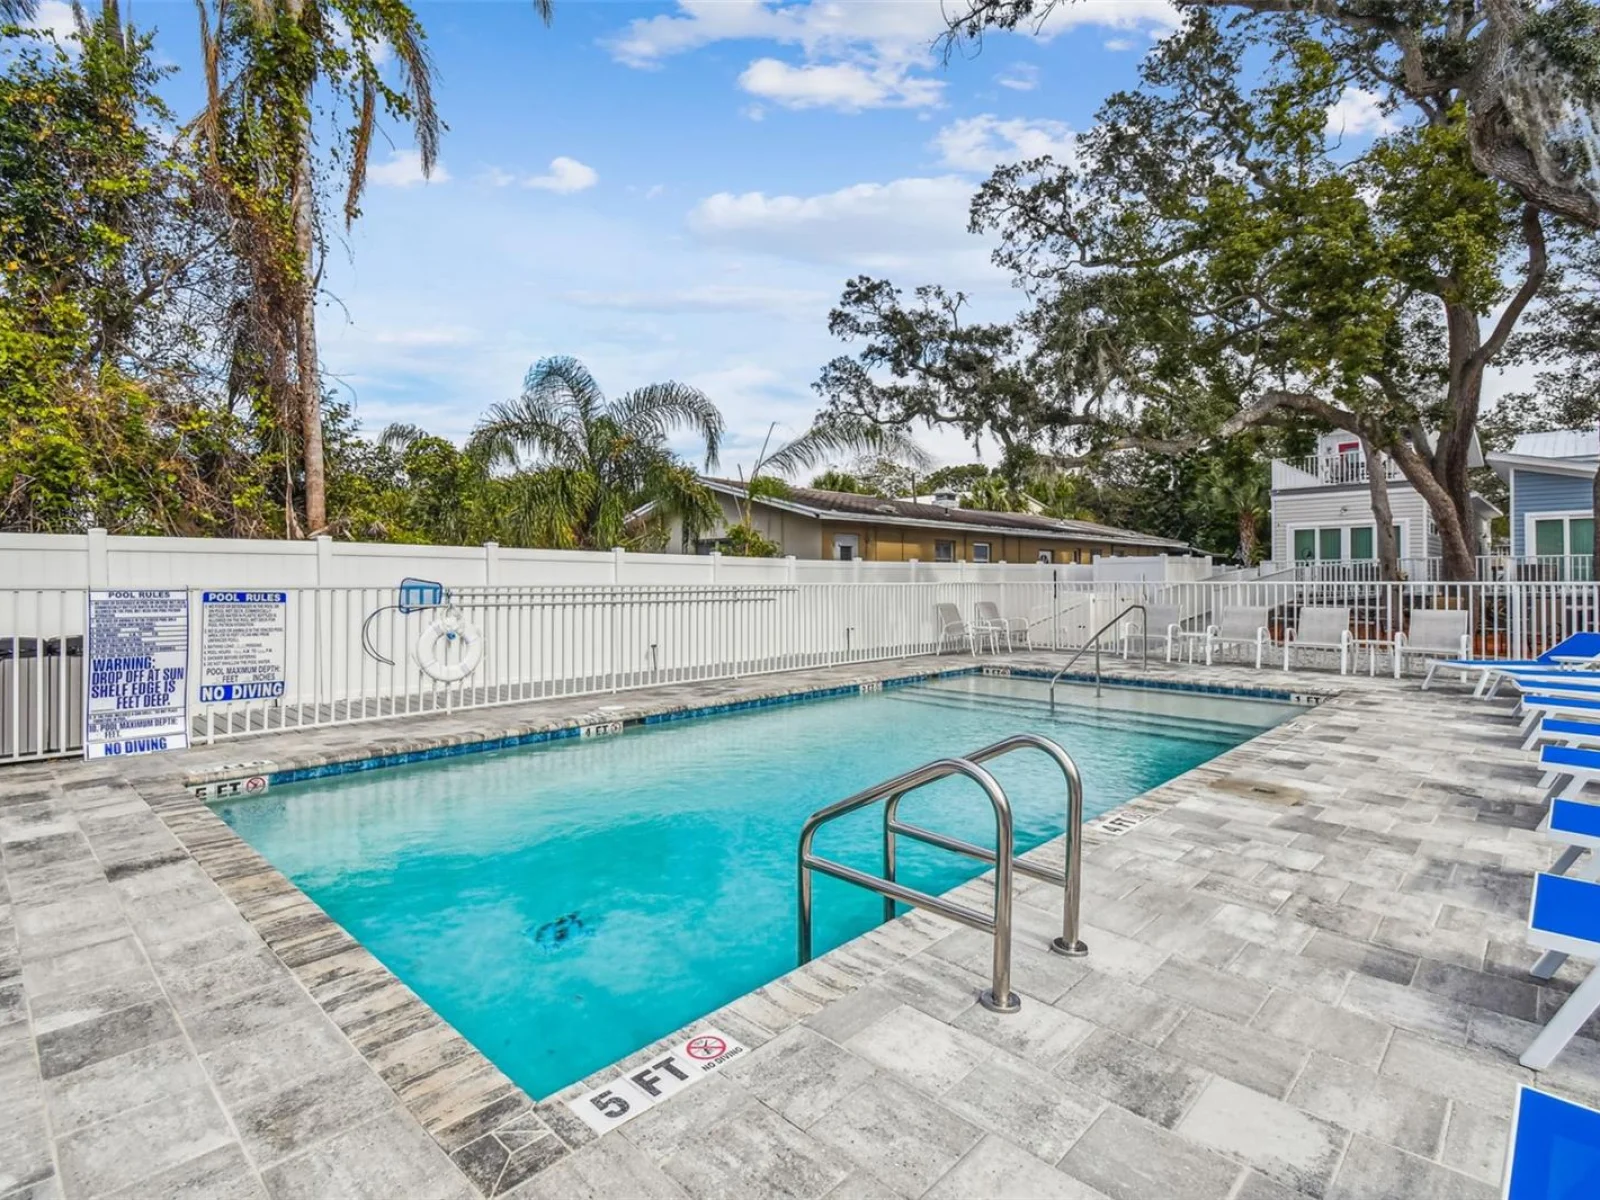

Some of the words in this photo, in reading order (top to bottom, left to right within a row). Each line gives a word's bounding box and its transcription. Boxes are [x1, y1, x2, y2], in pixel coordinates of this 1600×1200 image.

[209, 593, 240, 602] POOL
[246, 594, 281, 602] RULES
[93, 656, 156, 671] WARNING:
[206, 667, 224, 675] POOL
[226, 666, 257, 674] MAXIMUM
[92, 671, 123, 685] DROP
[126, 670, 144, 682] OFF
[148, 669, 160, 680] AT
[163, 667, 184, 680] SUN
[222, 675, 239, 683] FEET
[91, 684, 128, 698] SHELF
[132, 682, 161, 695] EDGE
[165, 681, 176, 692] IS
[202, 686, 224, 701] NO
[232, 682, 282, 699] DIVING
[116, 696, 140, 709] FEET
[144, 694, 171, 707] DEEP.
[100, 723, 117, 732] POOL
[118, 720, 152, 729] MAXIMUM
[105, 742, 121, 755] NO
[125, 737, 167, 753] DIVING
[701, 1061, 716, 1072] NO
[715, 1046, 743, 1065] DIVING
[590, 1090, 630, 1118] 5
[631, 1056, 689, 1097] FT
